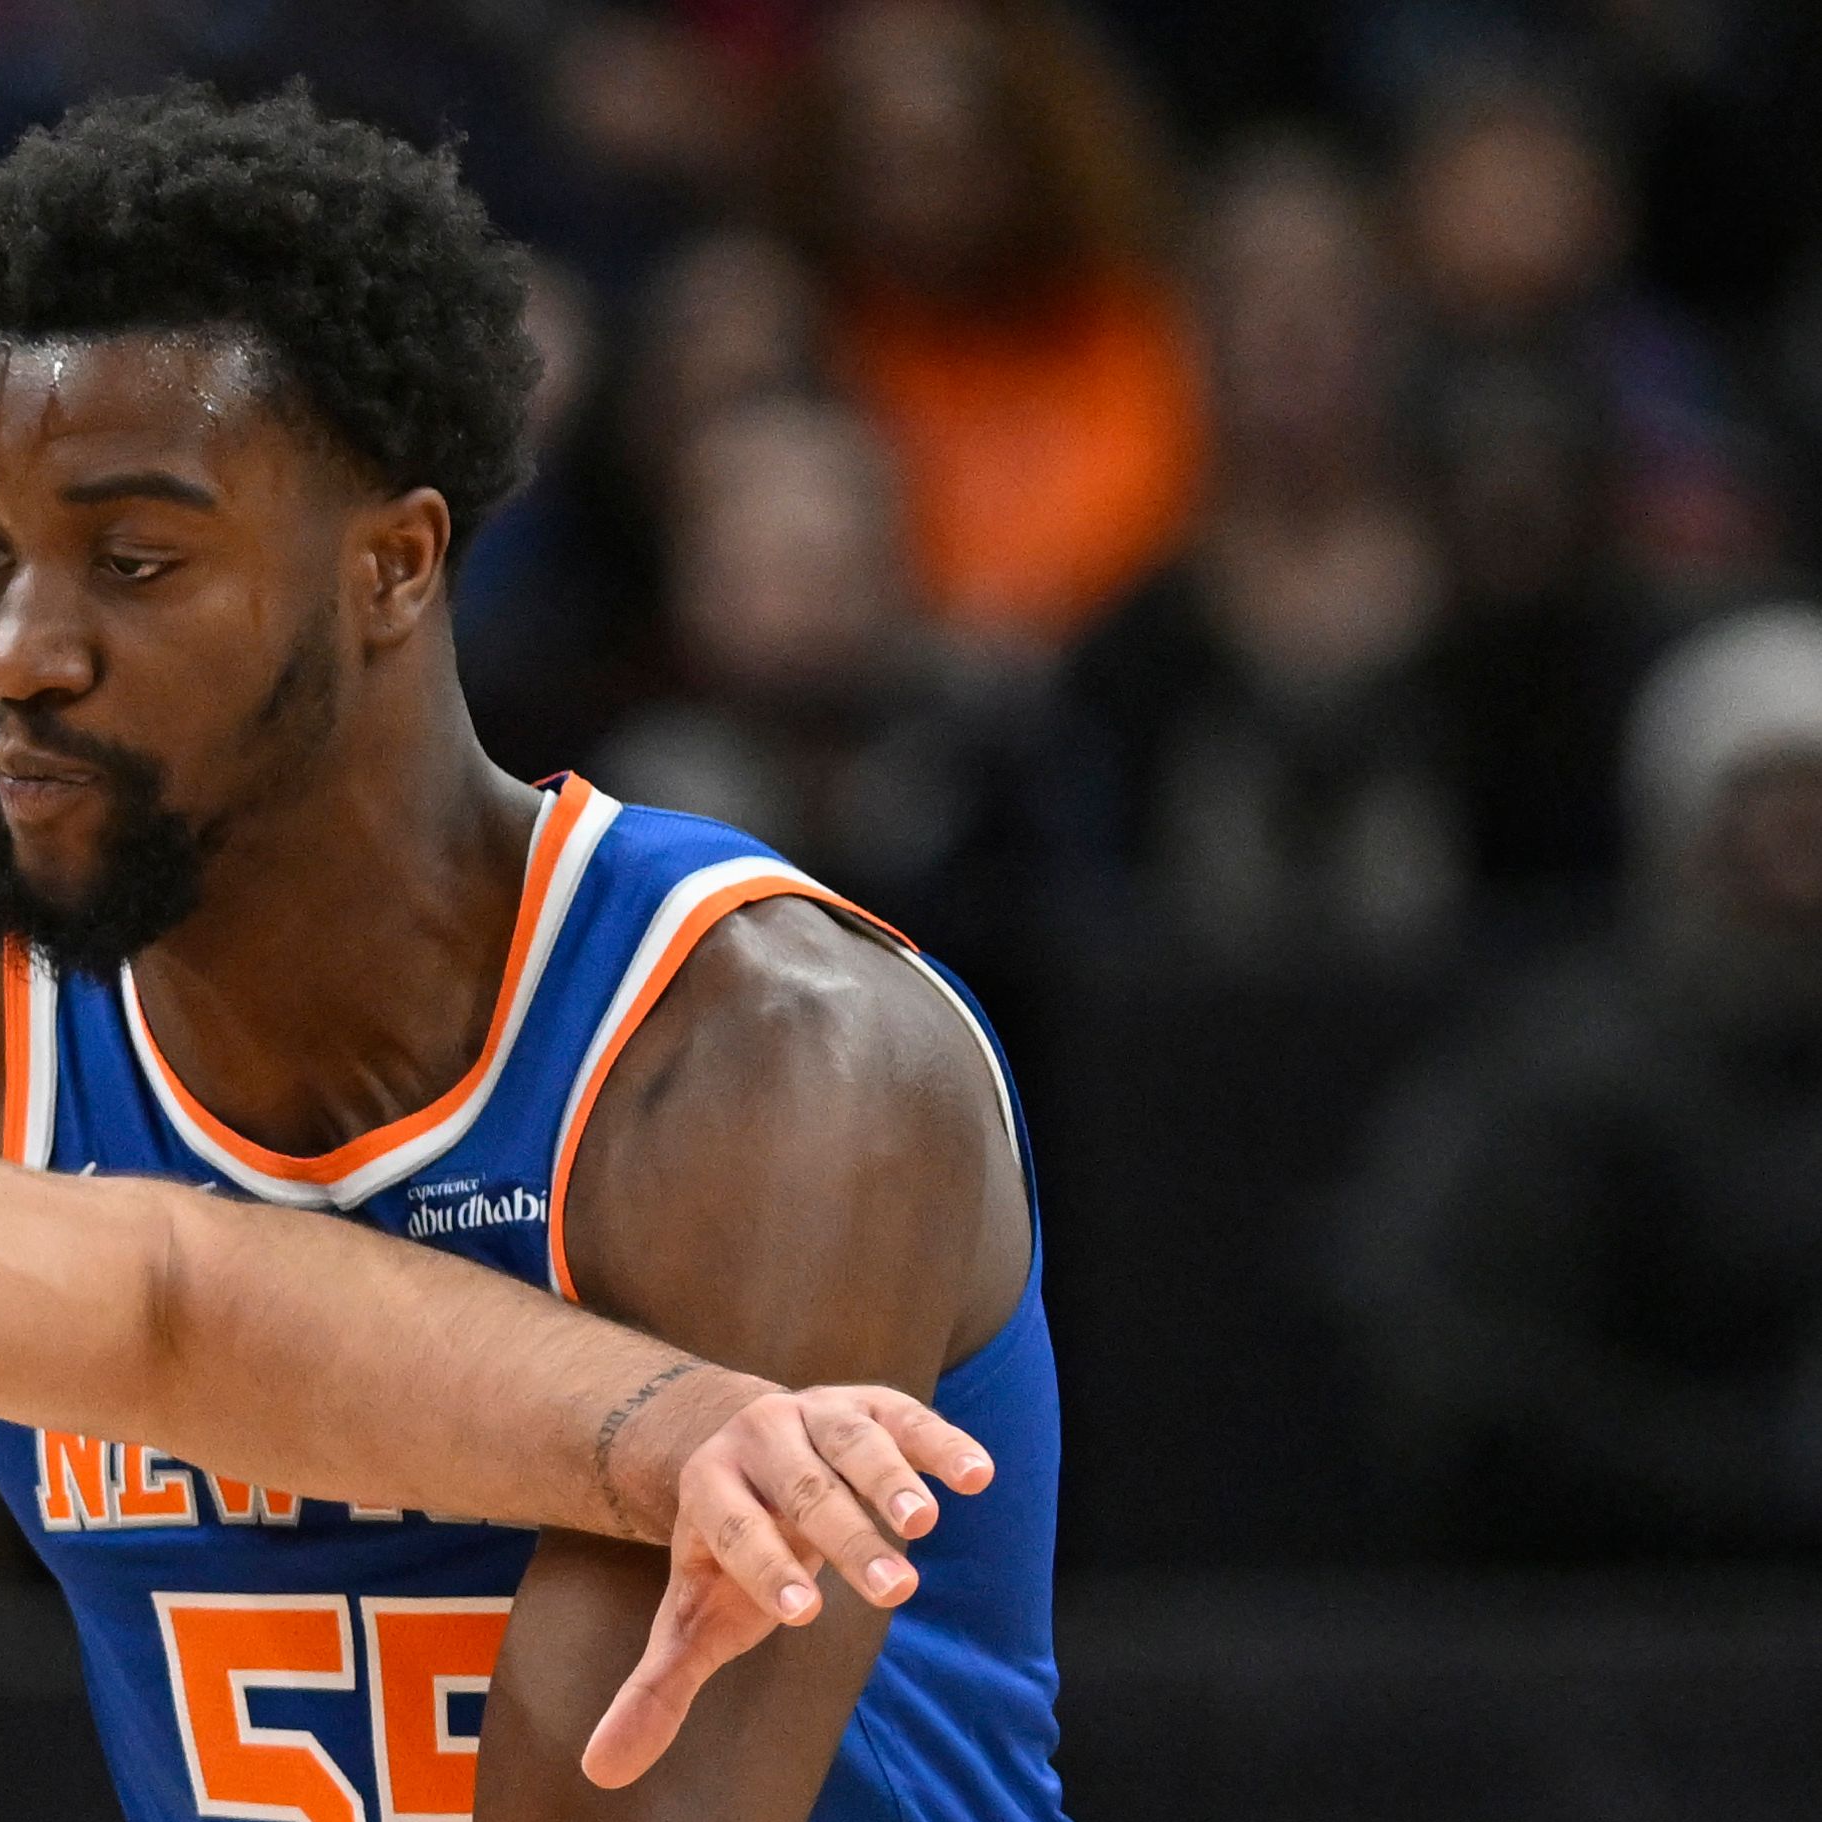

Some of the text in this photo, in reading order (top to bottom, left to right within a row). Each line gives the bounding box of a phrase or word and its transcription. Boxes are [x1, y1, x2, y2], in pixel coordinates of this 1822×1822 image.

[407, 1177, 481, 1203] experience
[407, 1186, 548, 1239] abu dhabi
